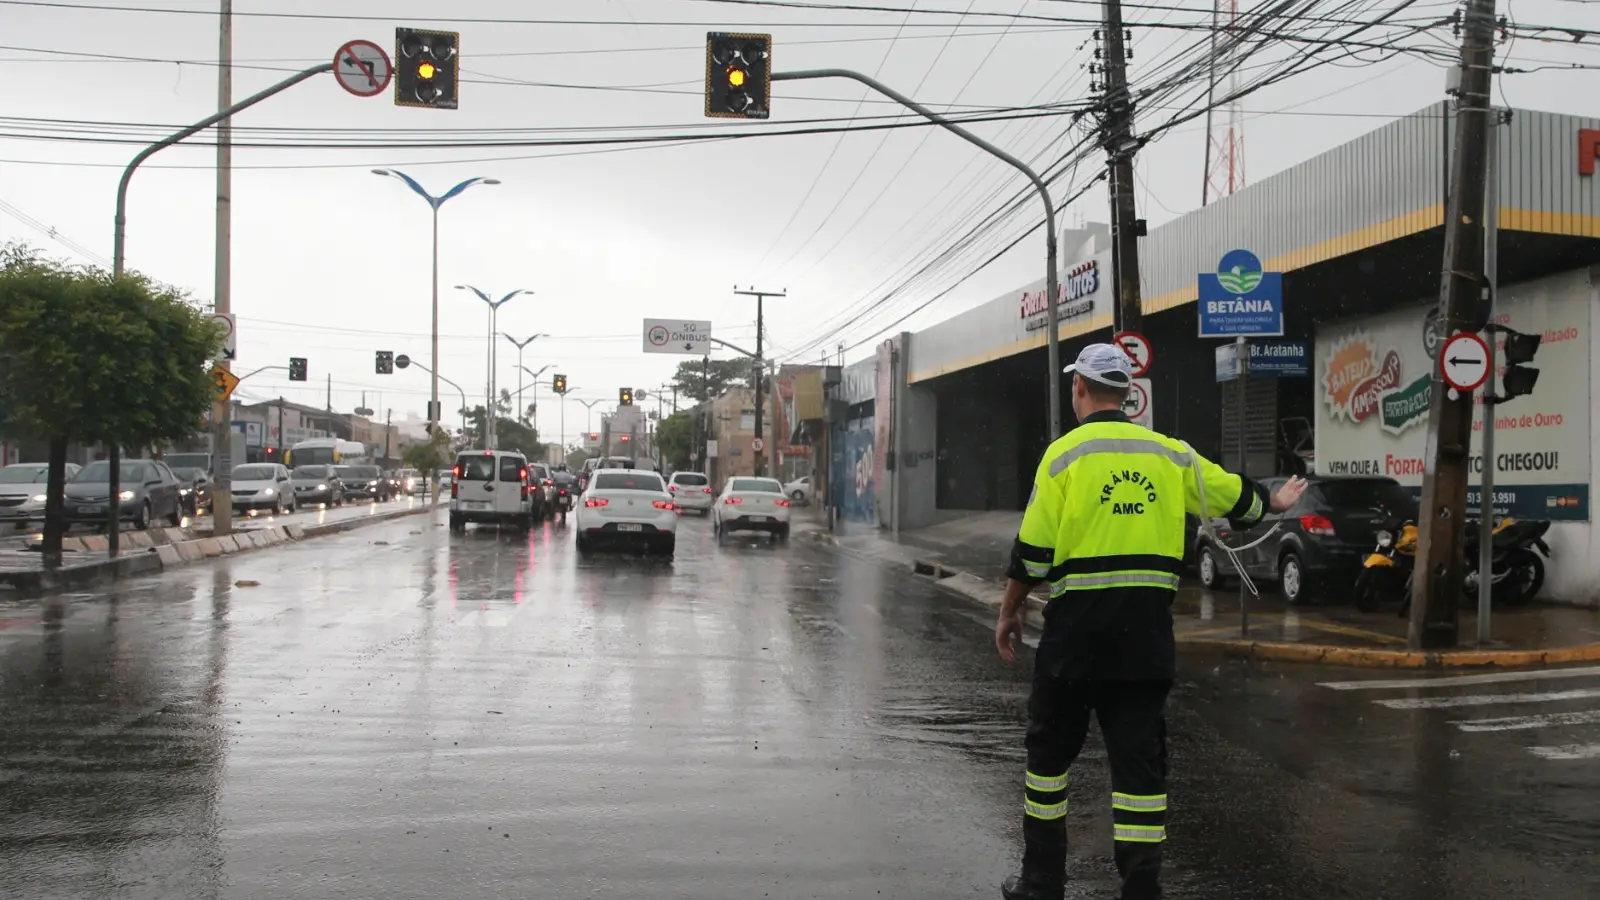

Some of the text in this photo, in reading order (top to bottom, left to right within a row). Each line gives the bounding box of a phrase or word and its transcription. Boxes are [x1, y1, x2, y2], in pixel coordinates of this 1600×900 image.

[1208, 297, 1273, 313] BETÂNIA
[1250, 343, 1304, 357] Br. Aratanha
[1519, 415, 1532, 428] de
[1534, 412, 1563, 427] Ouro
[1329, 461, 1349, 475] VEM
[1351, 460, 1371, 475] QUE
[1371, 460, 1380, 475] A
[1385, 453, 1425, 476] FORTA
[1497, 451, 1559, 472] CHEGOU!
[1112, 502, 1145, 515] AMC
